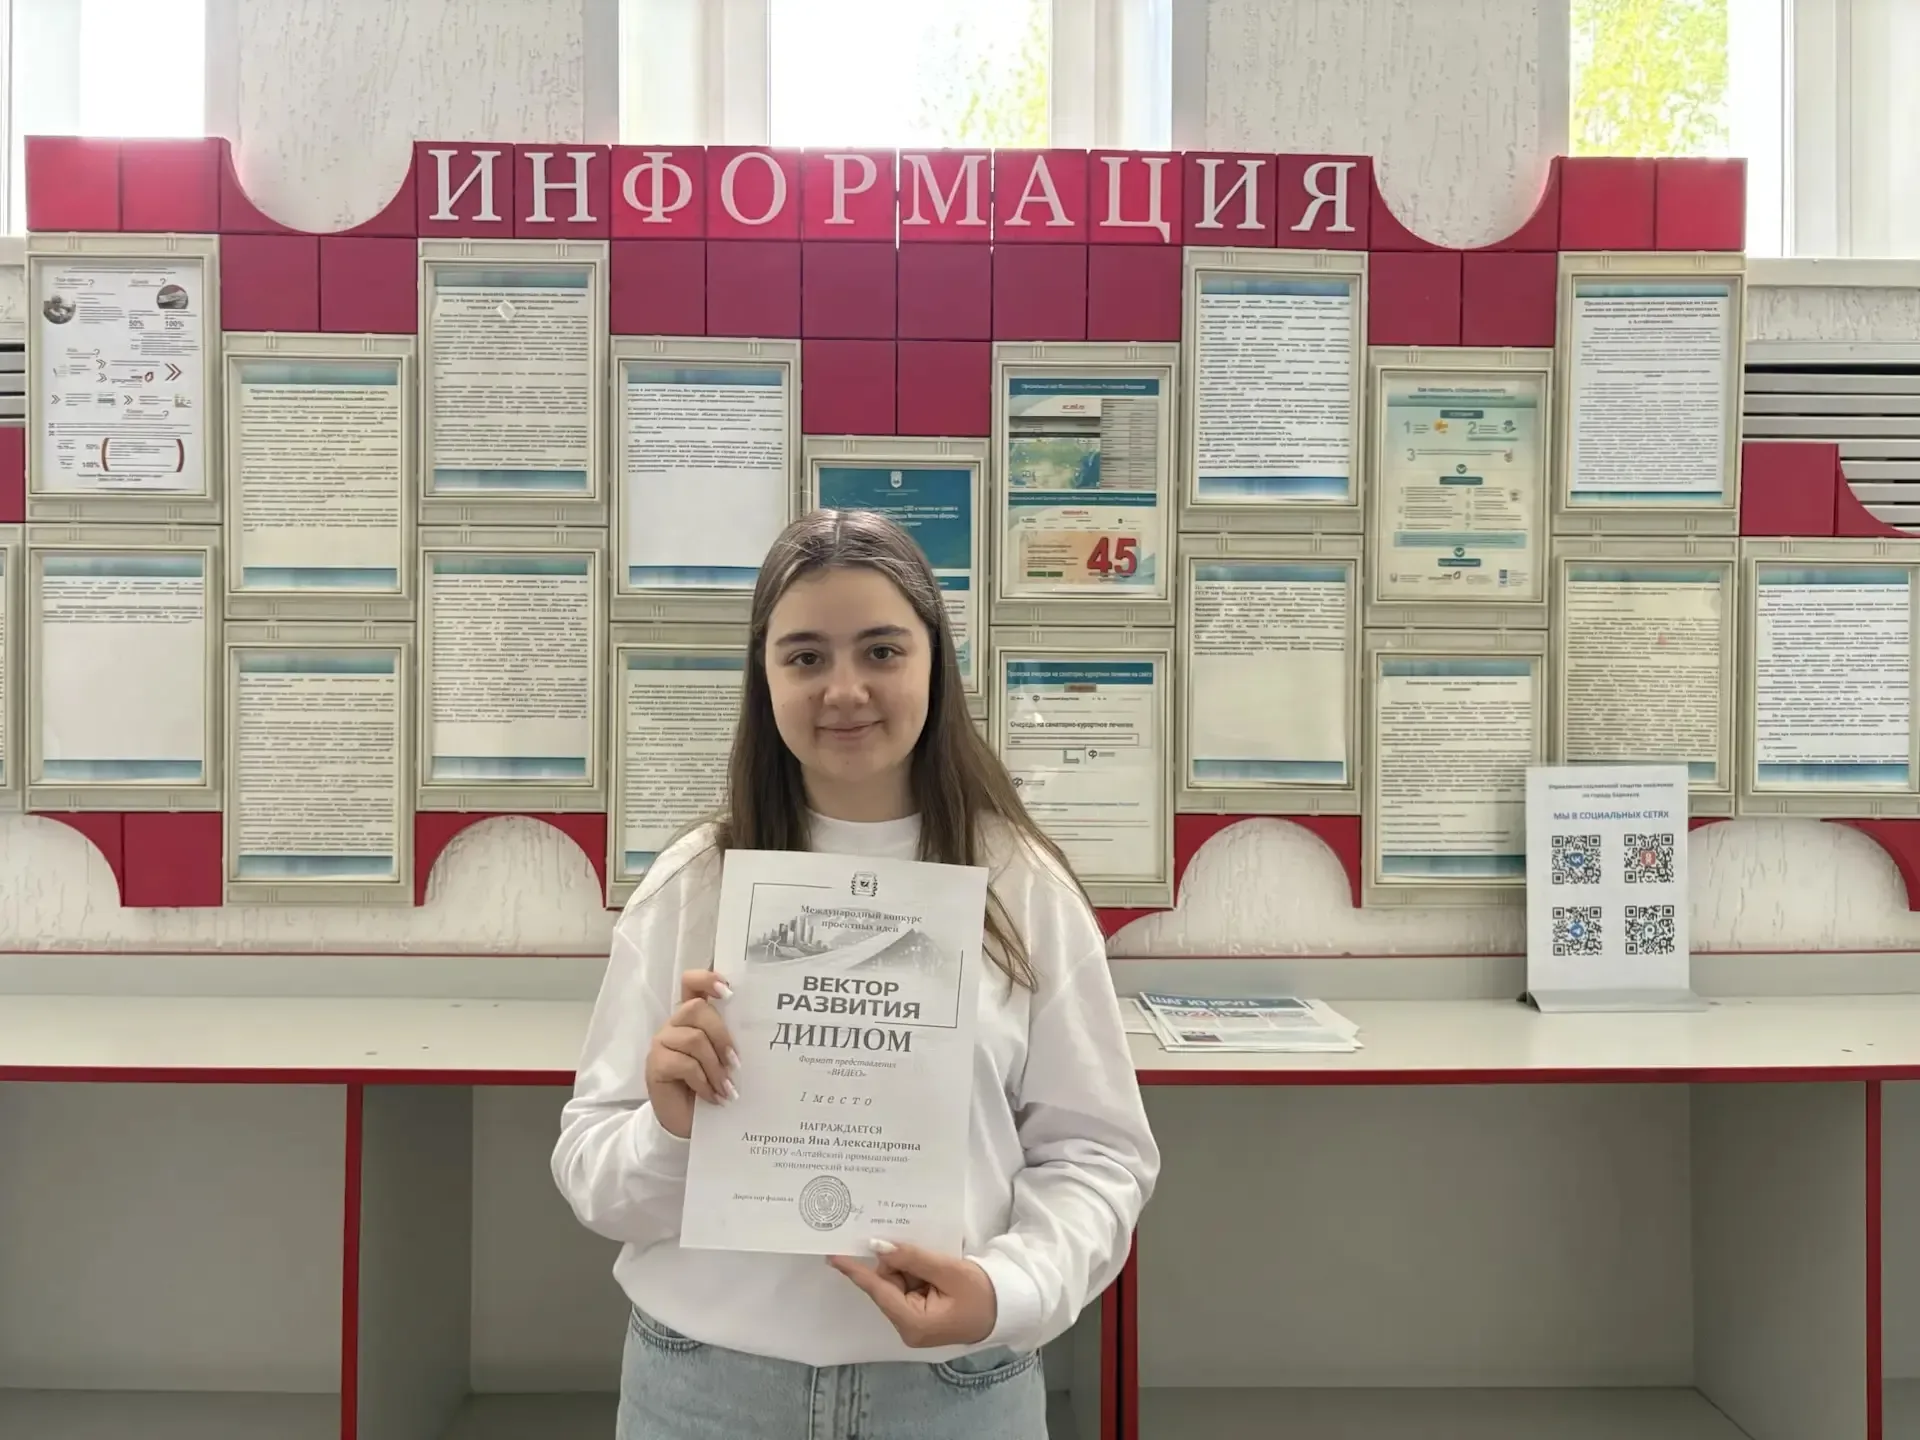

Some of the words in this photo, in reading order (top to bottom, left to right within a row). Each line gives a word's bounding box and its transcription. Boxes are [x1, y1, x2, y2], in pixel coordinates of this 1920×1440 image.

[428, 149, 1357, 243] ИНФОРМАЦИЯ
[1086, 536, 1138, 577] 45
[1553, 812, 1570, 820] МЫ
[1571, 812, 1578, 820] В
[1579, 811, 1641, 820] СОЦИАЛЬНЫХ
[1642, 810, 1669, 818] СЕТЯХ
[800, 904, 882, 920] Международный
[803, 975, 900, 997] ВЕКТОР
[776, 993, 921, 1020] РАЗВИТИЯ
[769, 1022, 913, 1053] ДИПЛОМ
[799, 1054, 834, 1066] Формат
[834, 1057, 897, 1069] представления
[813, 1093, 873, 1106] место
[799, 1121, 883, 1135] НАГРАЖДАЕТСЯ
[741, 1131, 806, 1146] Антропова
[808, 1134, 831, 1146] Яна
[832, 1136, 922, 1152] Александровна
